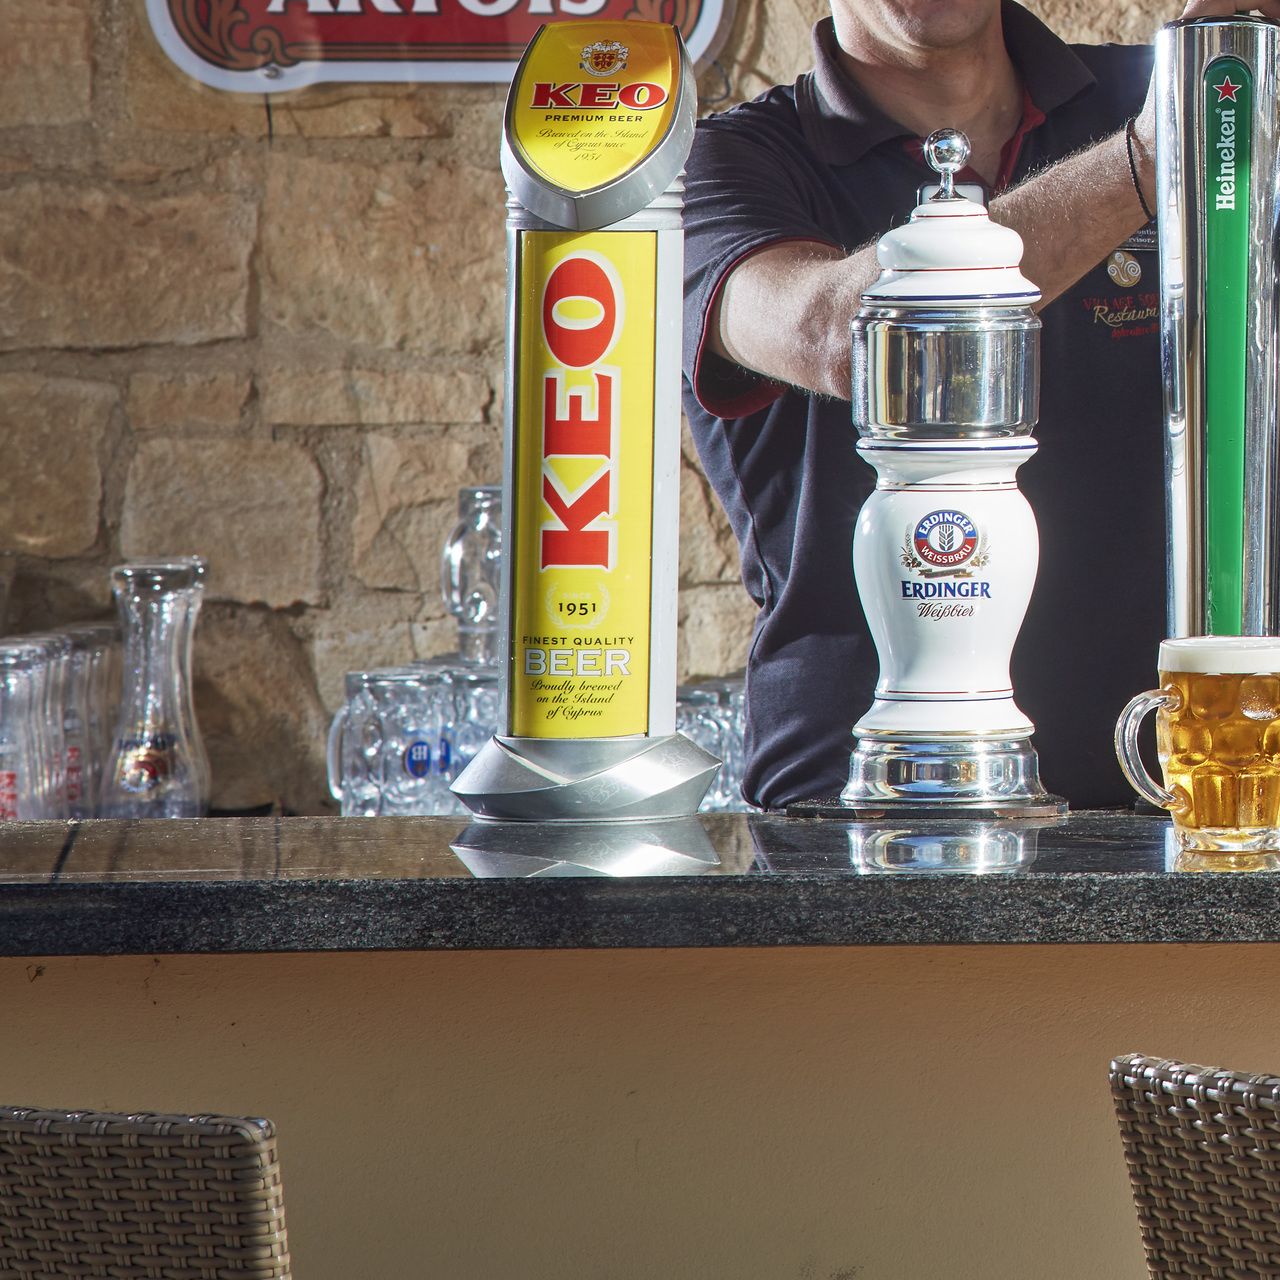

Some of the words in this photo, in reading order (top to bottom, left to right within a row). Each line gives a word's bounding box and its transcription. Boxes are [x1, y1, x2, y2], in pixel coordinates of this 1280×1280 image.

[530, 82, 669, 111] KEO
[536, 128, 578, 139] Brewed
[594, 128, 608, 138] the
[610, 129, 648, 139] Island
[554, 139, 567, 149] of
[566, 138, 602, 151] Cyprus
[1215, 108, 1236, 211] Heineken
[1093, 305, 1159, 327] Restaura
[540, 255, 620, 572] KEO
[918, 512, 974, 535] ERDINGER
[901, 580, 992, 600] ERDINGER
[558, 602, 597, 616] 1951
[917, 602, 975, 621] Weißbier
[522, 636, 568, 645] FINEST
[573, 637, 634, 646] QUALITY
[524, 647, 632, 677] BEER
[530, 679, 576, 694] Proudly
[578, 680, 623, 691] brewed
[551, 693, 569, 704] the
[572, 693, 615, 704] Island
[546, 705, 563, 719] of
[562, 705, 603, 720] Cyprus
